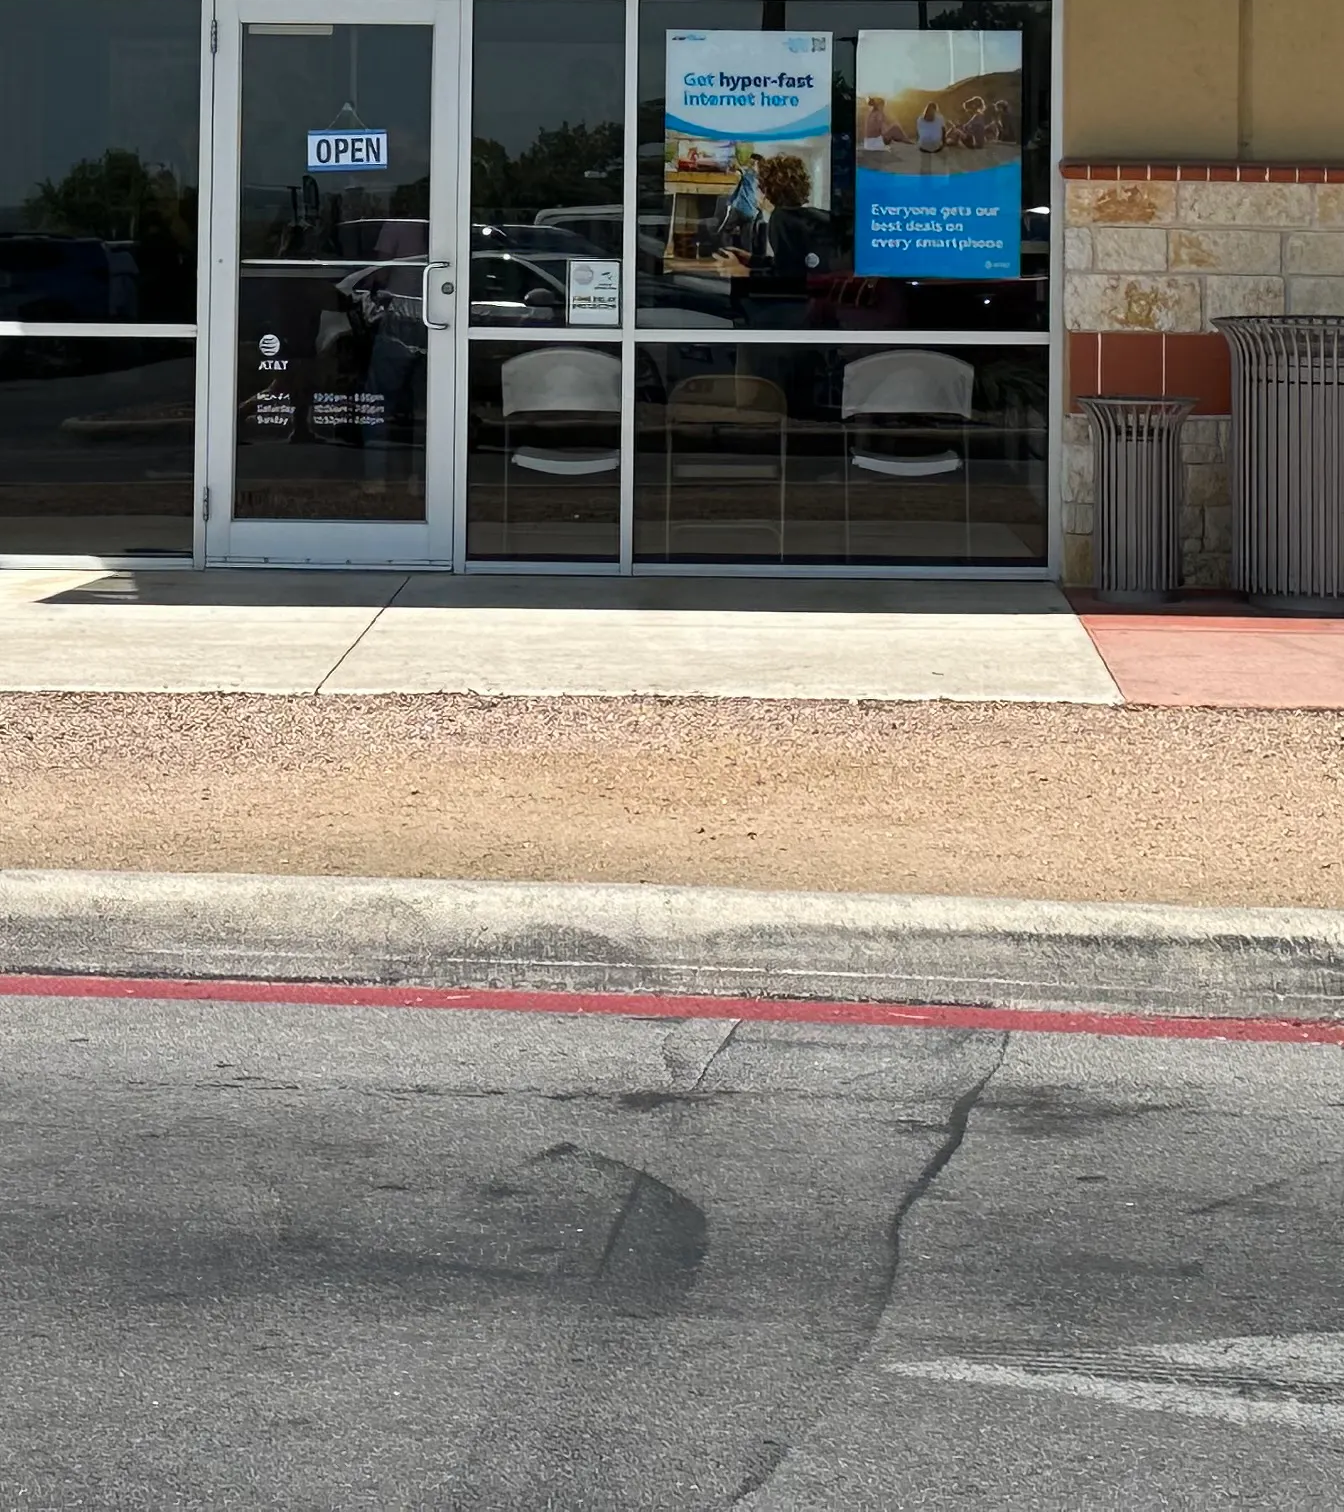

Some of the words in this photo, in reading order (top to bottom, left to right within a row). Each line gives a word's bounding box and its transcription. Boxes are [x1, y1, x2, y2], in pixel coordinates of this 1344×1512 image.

[684, 72, 716, 88] Get
[719, 71, 814, 92] hyper-fast
[760, 91, 799, 107] here
[316, 137, 380, 163] OPEN
[871, 203, 937, 219] Everyone
[941, 205, 972, 220] gets
[975, 206, 1001, 217] our
[871, 220, 903, 232] best
[906, 220, 943, 232] deals
[945, 223, 964, 232] on
[871, 239, 912, 251] every
[915, 237, 1004, 251] smartphone
